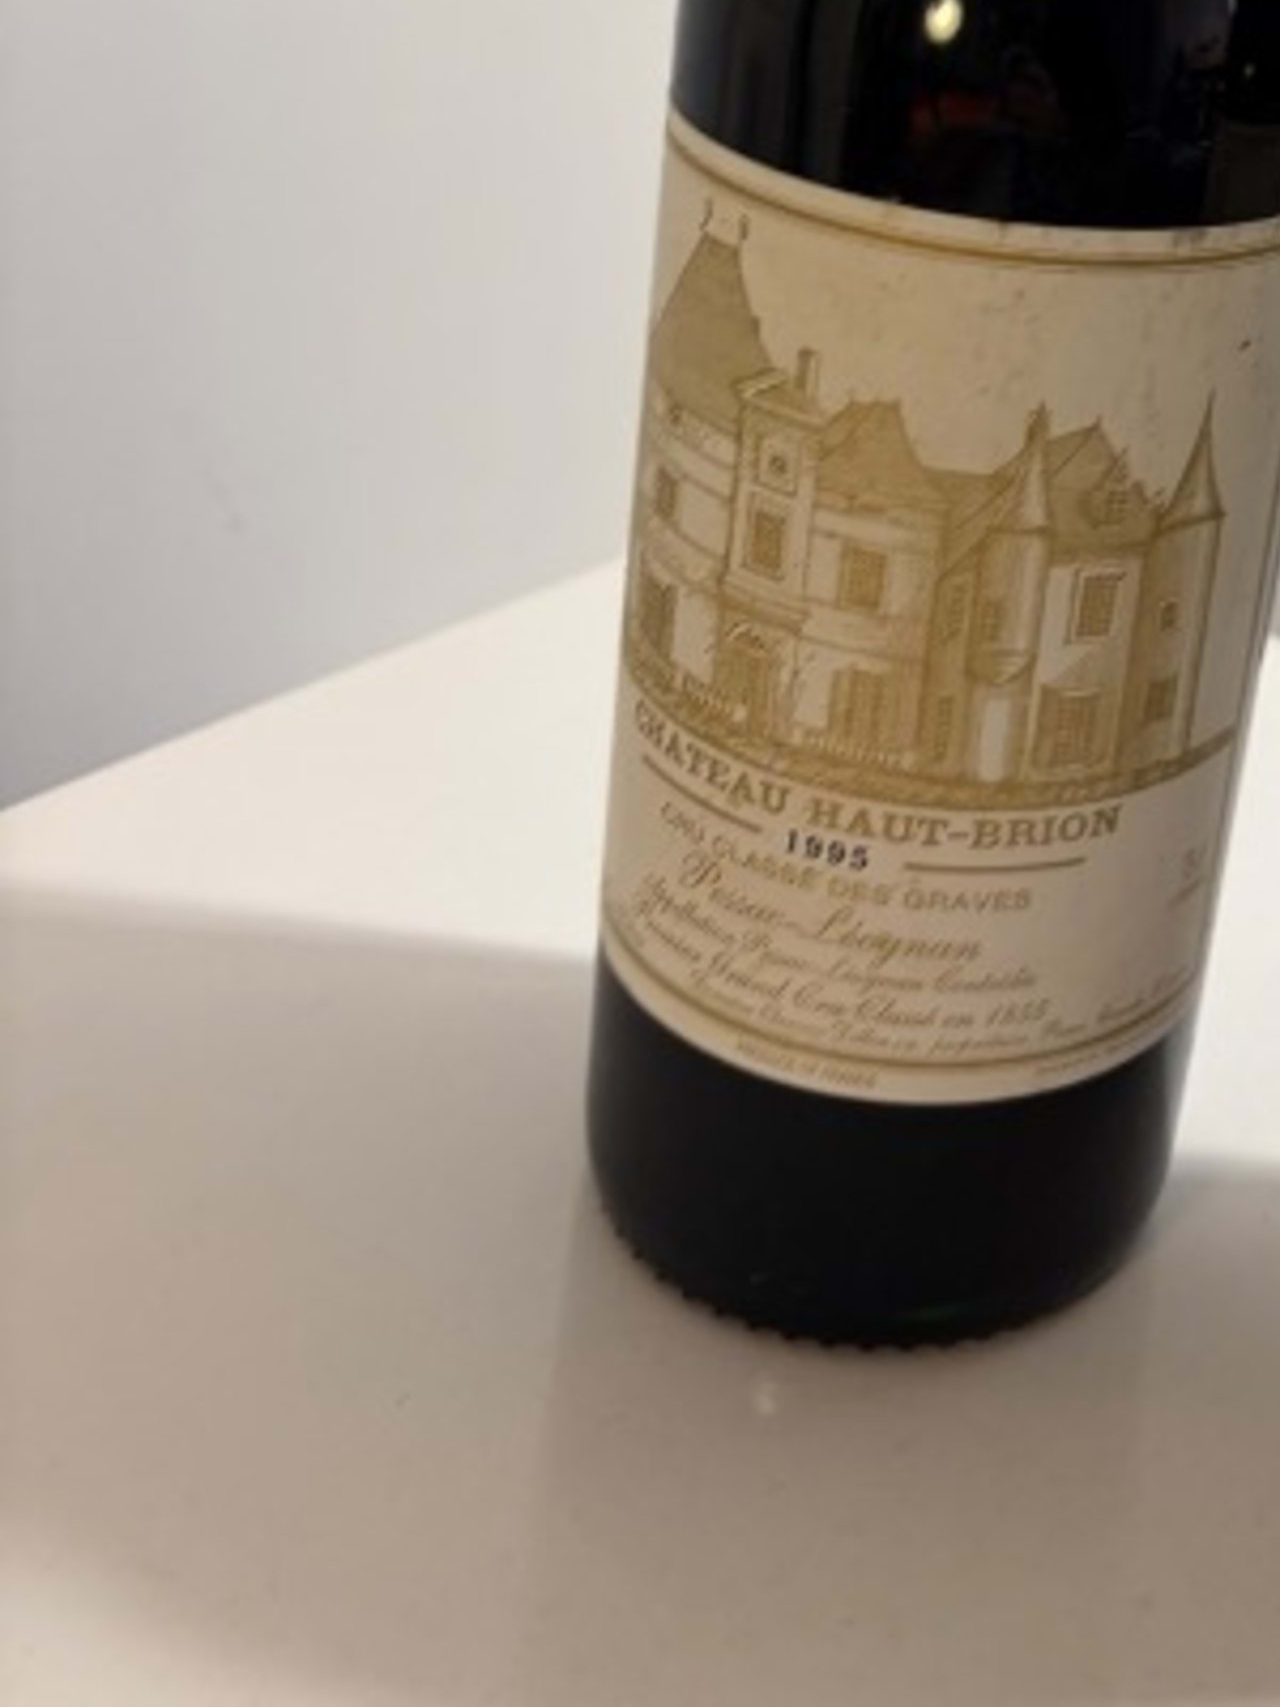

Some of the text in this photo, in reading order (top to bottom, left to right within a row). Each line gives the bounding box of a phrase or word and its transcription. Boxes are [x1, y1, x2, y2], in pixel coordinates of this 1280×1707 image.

[634, 699, 1124, 851] CHATEAU HAUT-BRION
[785, 828, 869, 872] 1995
[904, 886, 1032, 916] GRAVES
